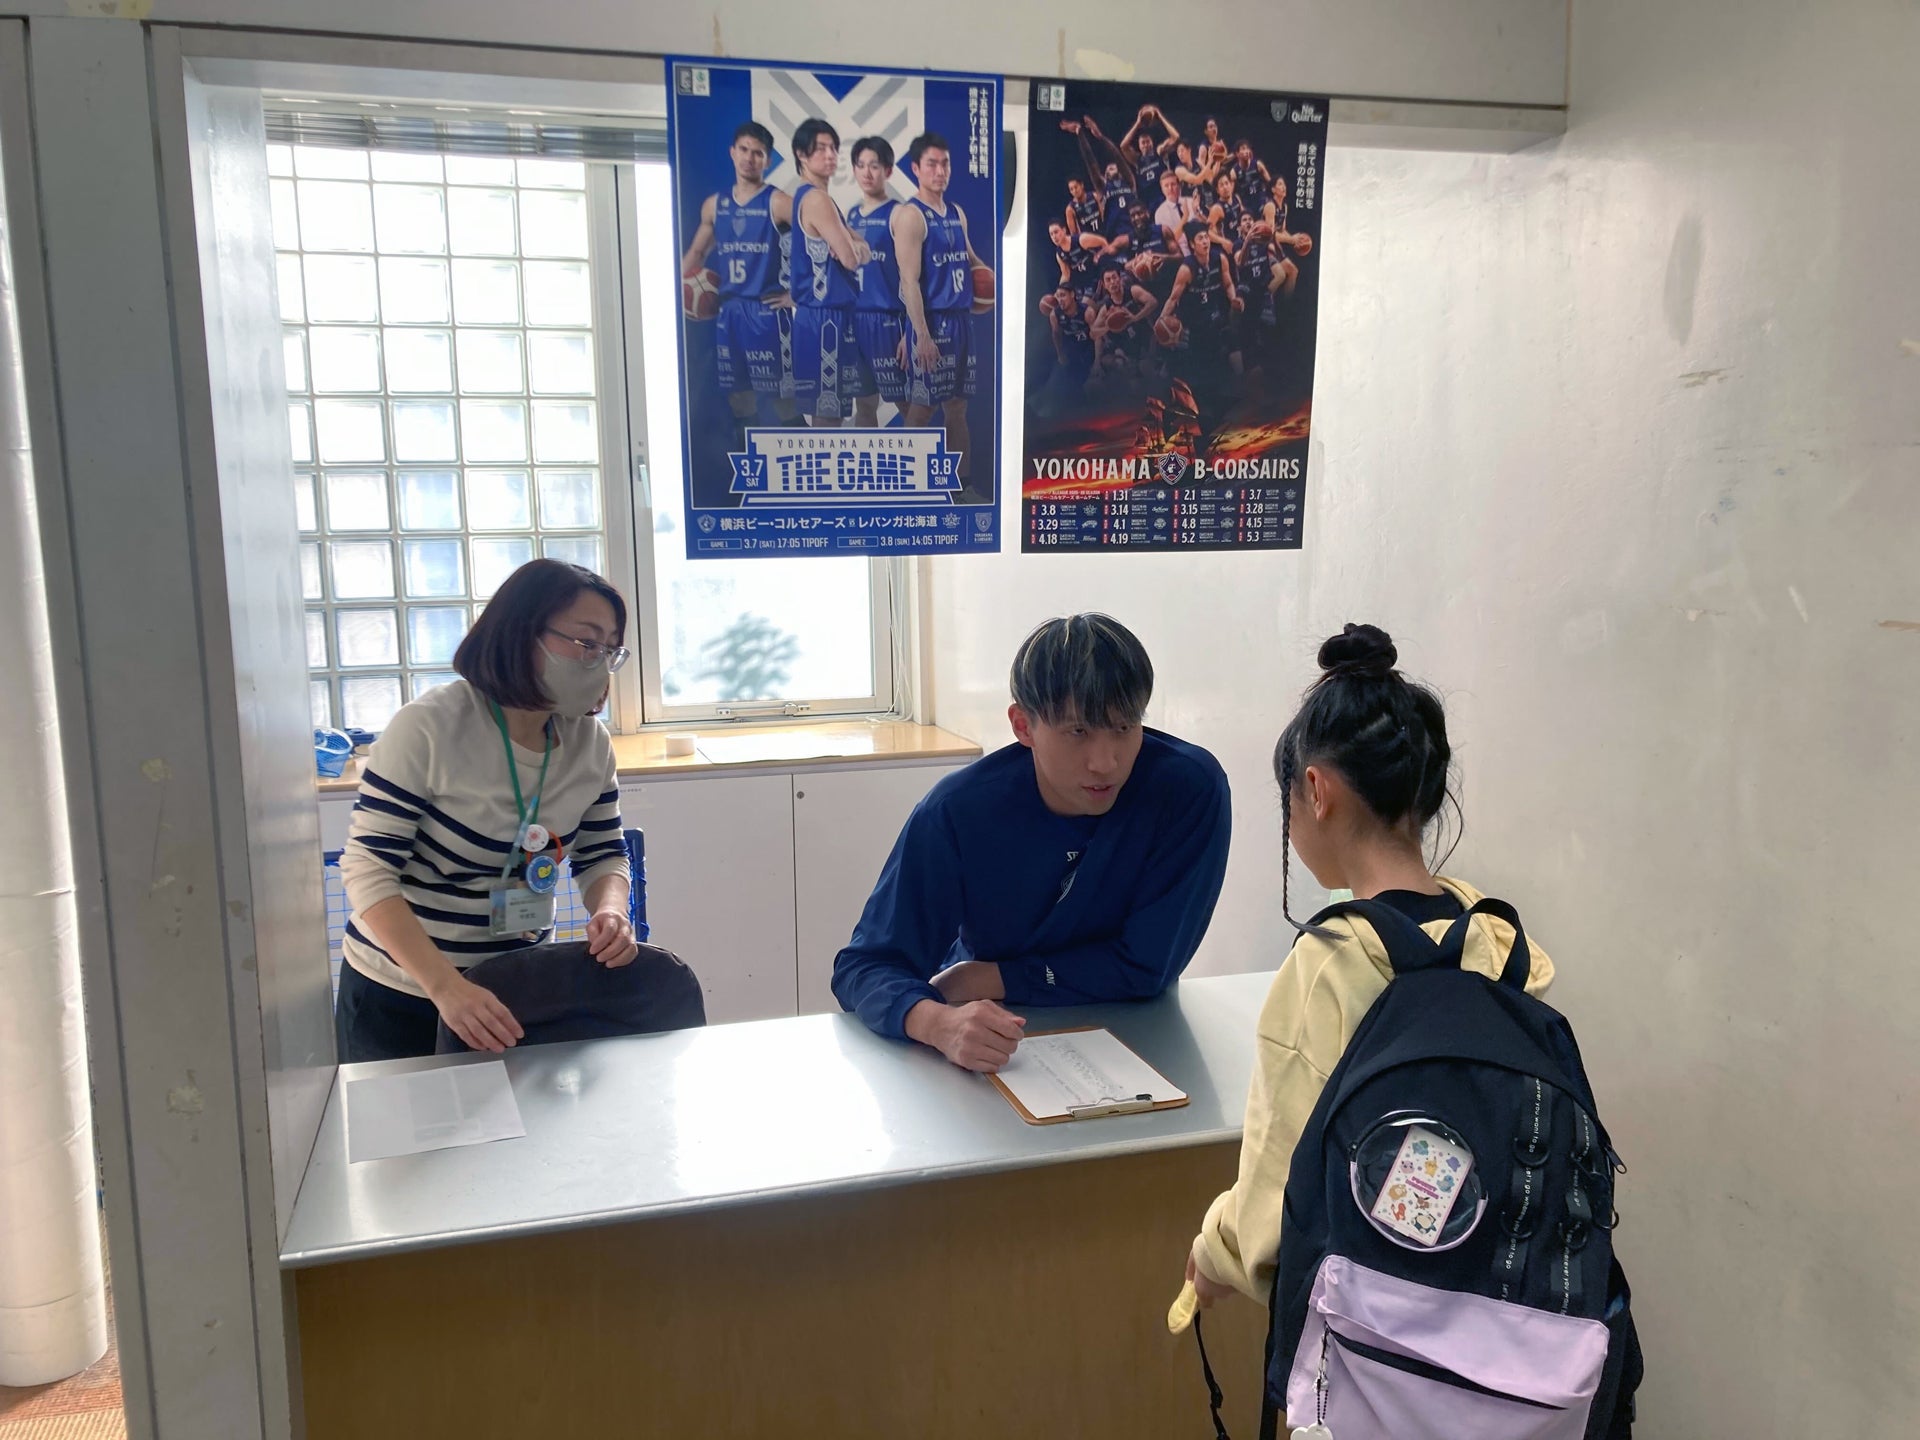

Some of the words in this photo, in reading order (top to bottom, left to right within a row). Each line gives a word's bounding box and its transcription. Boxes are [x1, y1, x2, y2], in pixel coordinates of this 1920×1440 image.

[1291, 111, 1323, 123] Quarter
[1295, 143, 1308, 208] 勝利のために
[728, 259, 746, 284] 15
[777, 439, 858, 449] YOKOHAMA
[868, 439, 915, 448] ARENA
[740, 458, 764, 477] 3.7
[776, 452, 832, 491] THE
[837, 451, 916, 491] GAME
[930, 458, 952, 475] 3.8
[1033, 458, 1151, 480] YOKOHAMA
[1194, 458, 1300, 480] B-CORSAIRS
[745, 477, 760, 488] SAT
[934, 476, 949, 486] SUN
[1113, 490, 1128, 501] 1.31
[1184, 490, 1196, 501] 2.1
[1249, 489, 1262, 500] 3.7
[1041, 504, 1056, 516] 3.8
[1111, 504, 1129, 516] 3.14
[1180, 503, 1198, 515] 3.15
[1245, 503, 1264, 514] 3.28
[720, 516, 846, 531] 横浜ビー・コルセアーズ
[858, 515, 938, 529] レバンガ北海道
[1038, 519, 1058, 530] 3.29
[1113, 519, 1126, 530] 4.1
[1182, 518, 1196, 529] 4.8
[1246, 517, 1262, 528] 4.15
[880, 536, 893, 547] 3.8
[912, 536, 933, 546] 14:05
[934, 535, 959, 545] TIPOFF
[1039, 533, 1058, 545] 4.18
[1110, 533, 1128, 544] 4.19
[1181, 532, 1195, 544] 5.2
[1246, 531, 1260, 542] 5.3
[744, 538, 757, 549] 3.7
[777, 538, 800, 549] 17:05
[801, 537, 829, 548] TIPOFF
[1529, 1144, 1536, 1153] go
[1524, 1184, 1531, 1194] go
[1505, 1259, 1512, 1269] go
